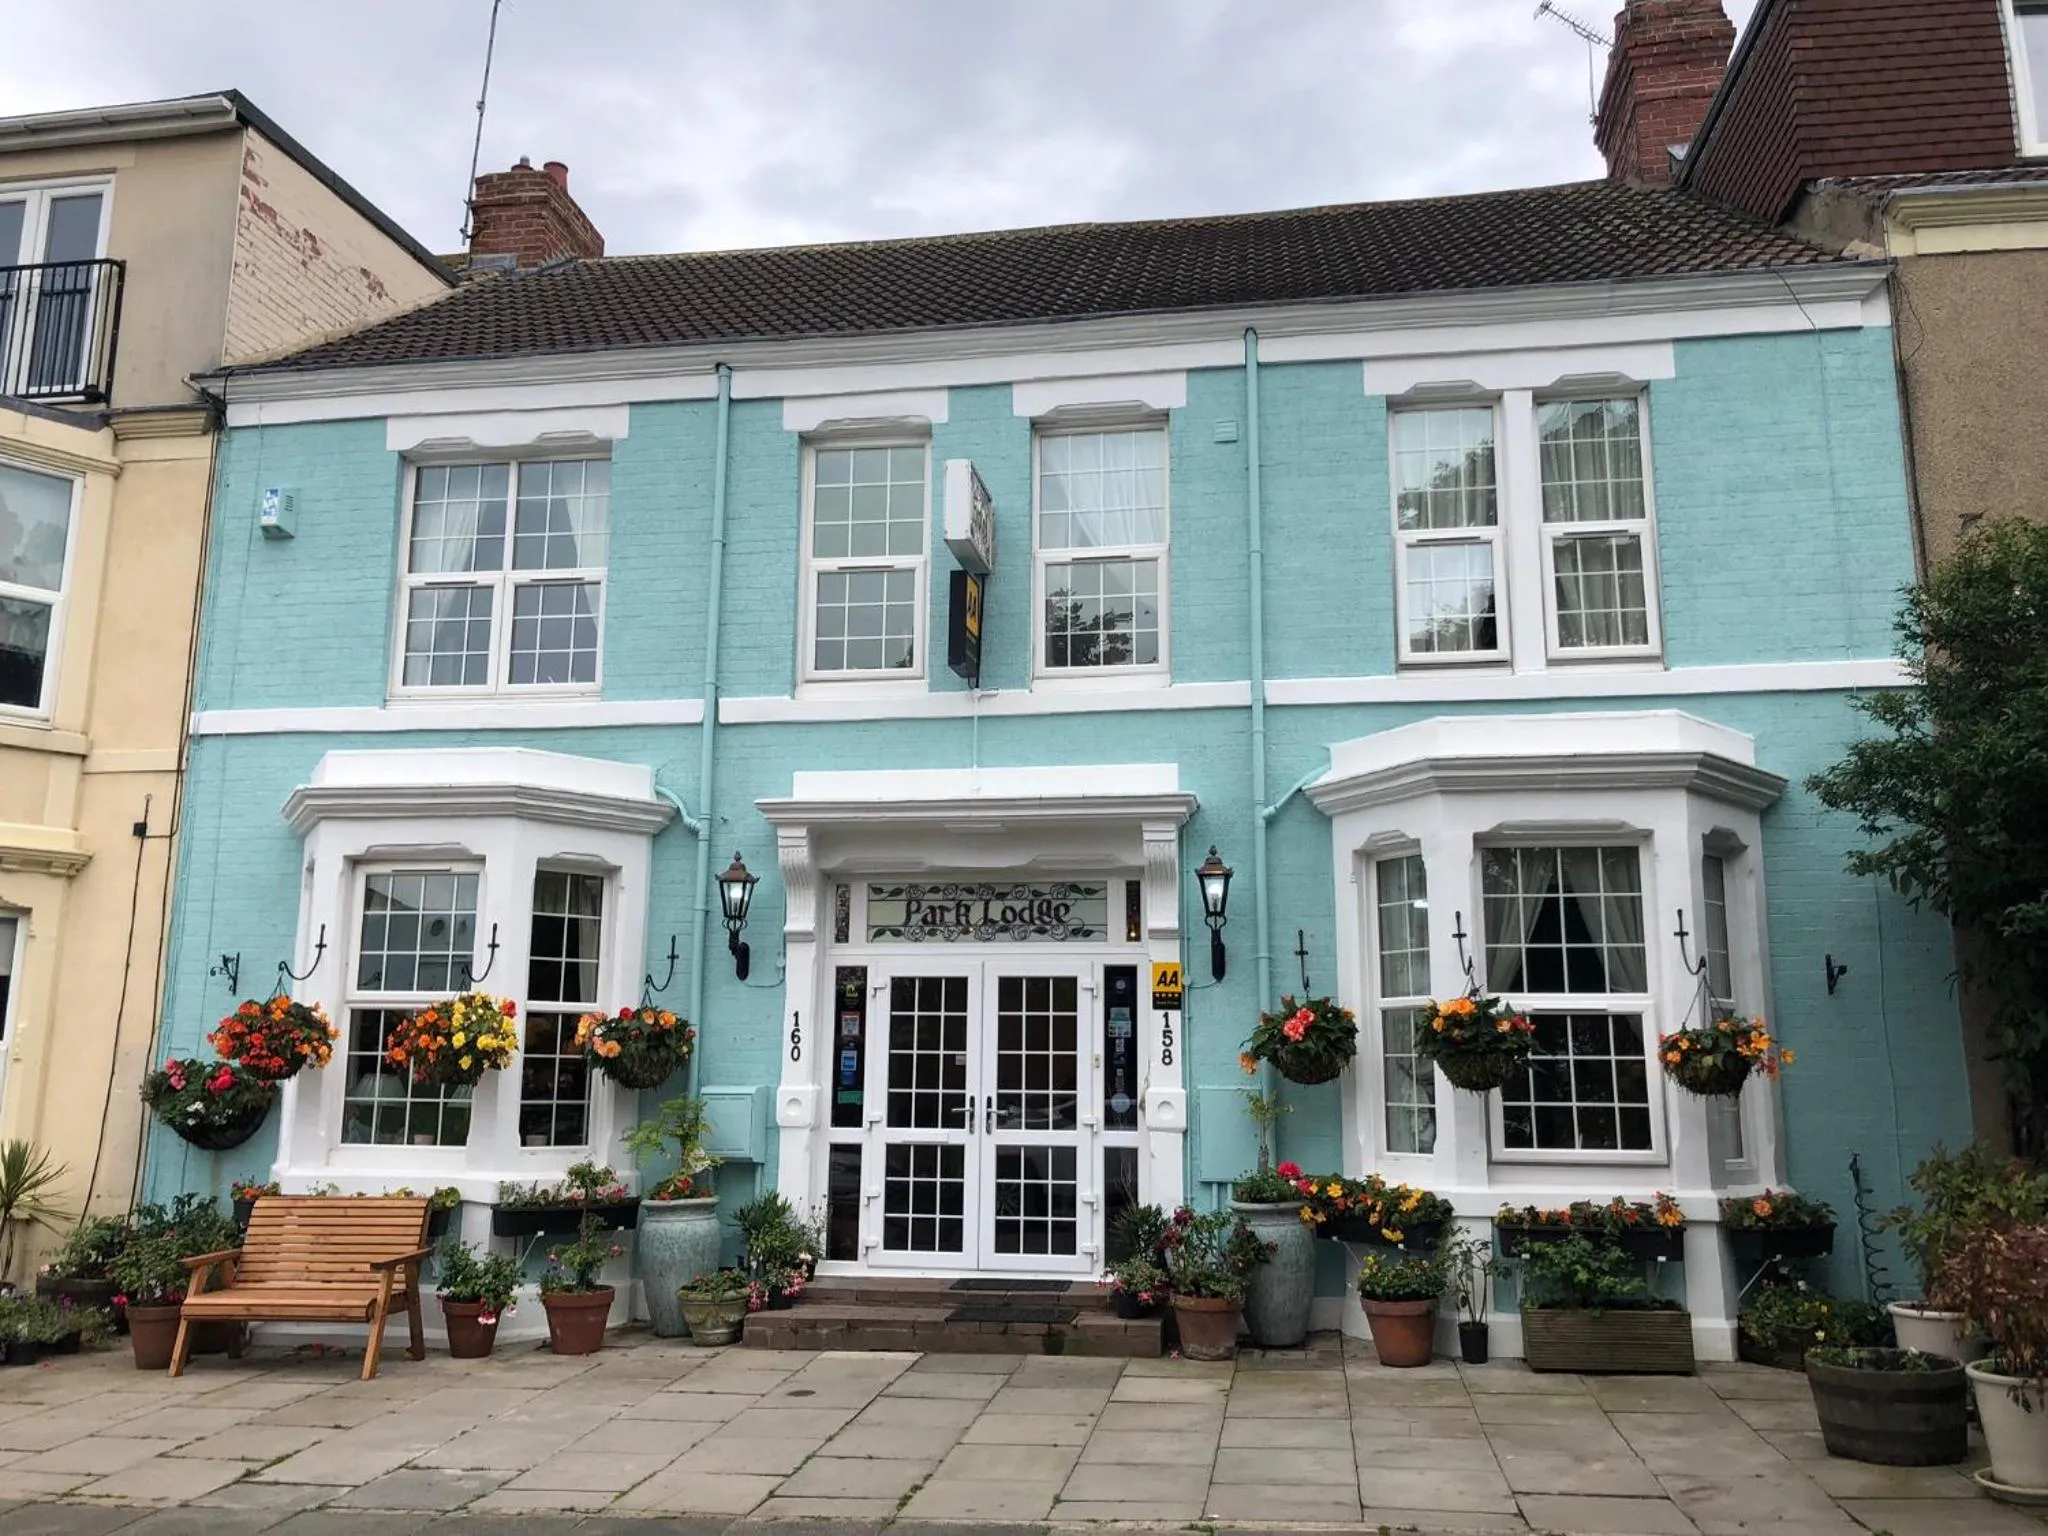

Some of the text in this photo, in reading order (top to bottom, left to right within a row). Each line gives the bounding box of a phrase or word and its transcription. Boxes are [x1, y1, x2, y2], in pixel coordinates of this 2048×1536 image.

[904, 900, 1071, 927] Park Lodge
[1157, 970, 1179, 987] AA
[791, 1010, 801, 1062] 160
[1161, 1011, 1174, 1066] 158
